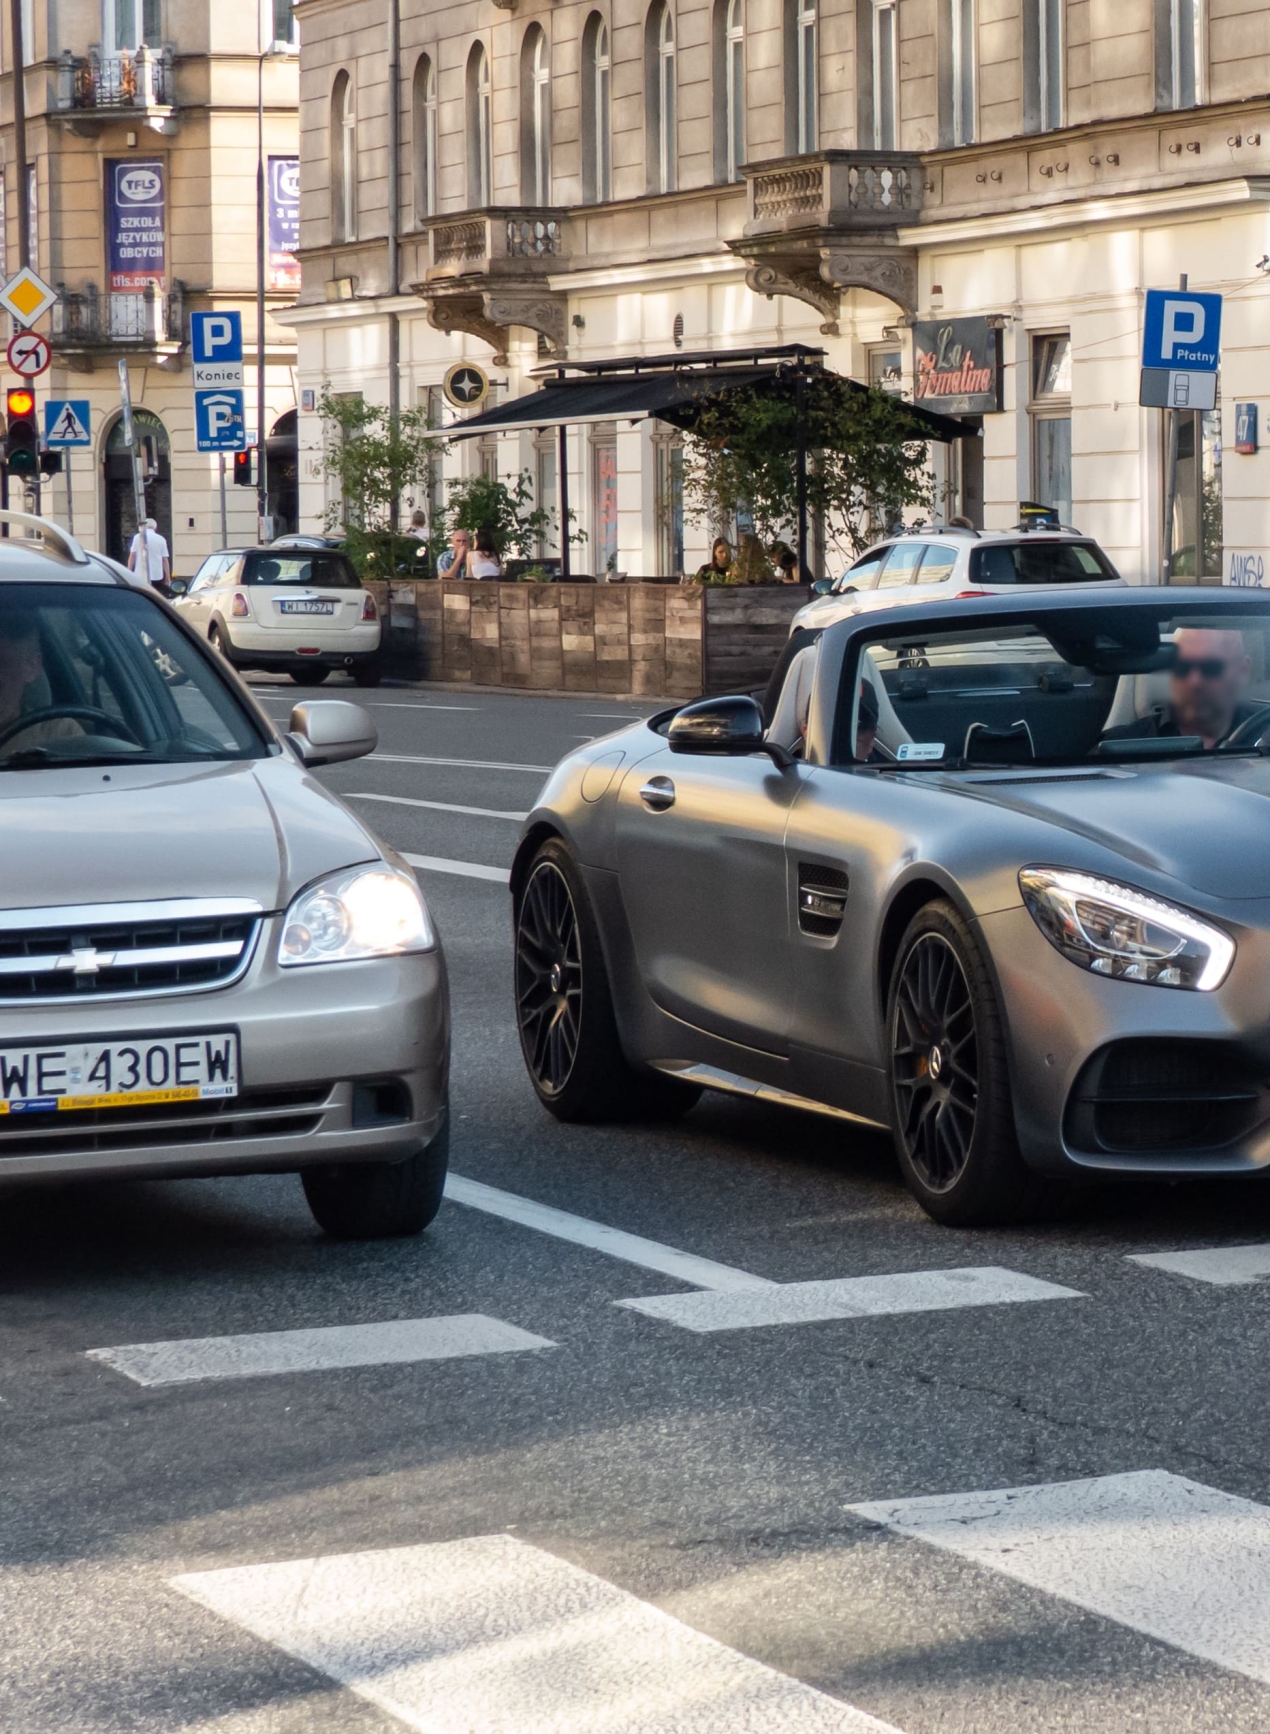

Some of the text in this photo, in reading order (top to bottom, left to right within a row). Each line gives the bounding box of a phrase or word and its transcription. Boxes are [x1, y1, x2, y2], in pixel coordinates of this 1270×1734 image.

[125, 179, 156, 190] TFLS
[120, 216, 161, 228] SZKOŁA
[116, 230, 165, 246] JĘZYKÓW
[119, 247, 163, 259] OBCYCH
[203, 317, 232, 357] P
[1161, 299, 1206, 360] P
[937, 326, 964, 369] La
[1177, 349, 1216, 365] Płatny
[196, 370, 241, 382] Koniec
[208, 405, 232, 438] P
[1, 1039, 231, 1099] WE 430EW
